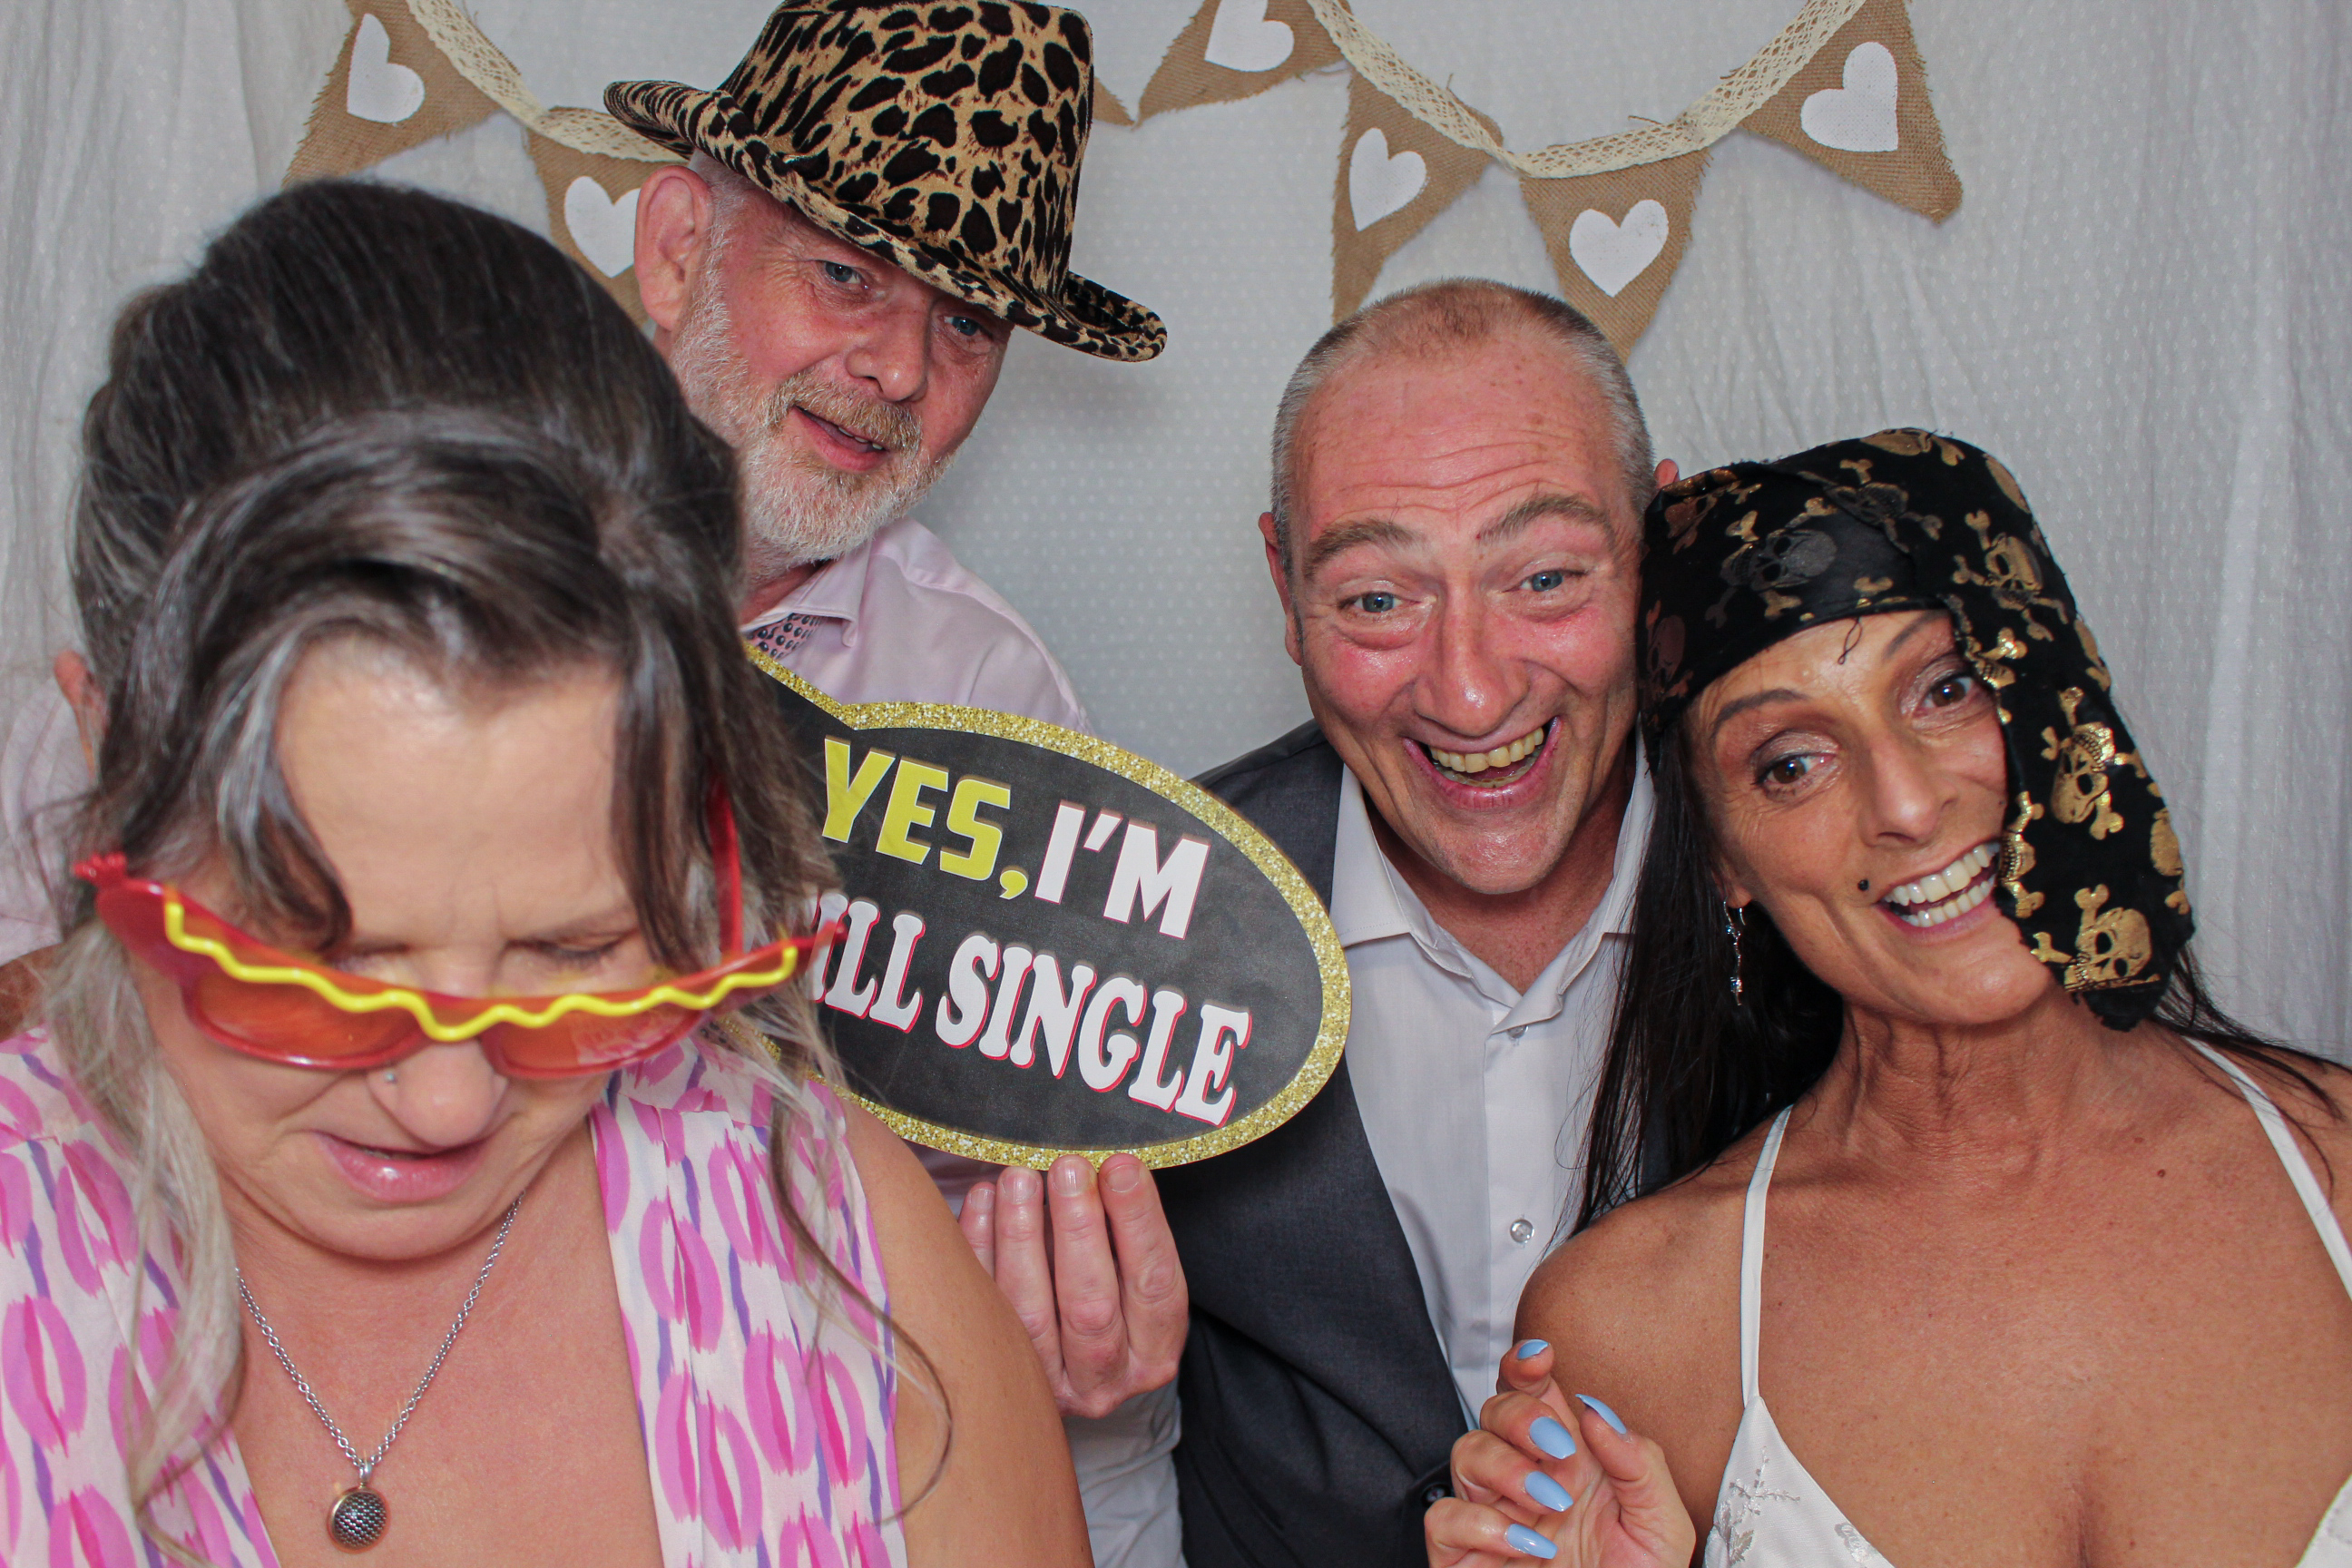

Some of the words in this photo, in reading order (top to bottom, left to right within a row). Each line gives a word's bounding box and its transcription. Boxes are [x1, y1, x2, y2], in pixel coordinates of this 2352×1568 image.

[822, 738, 1028, 900] YES,
[1034, 801, 1210, 939] I'M
[804, 891, 926, 1034] ILL
[936, 935, 1252, 1127] SINGLE
